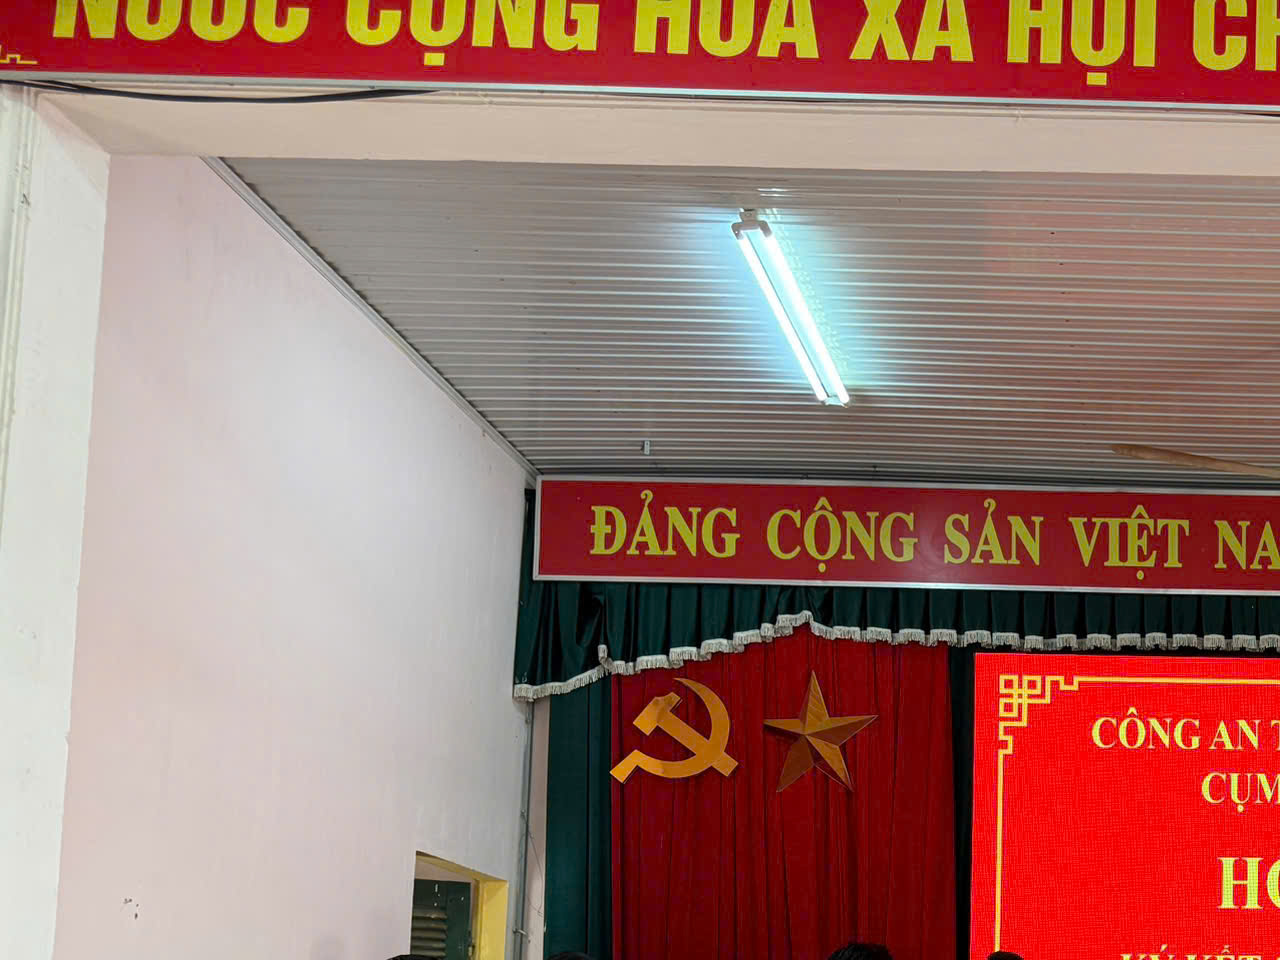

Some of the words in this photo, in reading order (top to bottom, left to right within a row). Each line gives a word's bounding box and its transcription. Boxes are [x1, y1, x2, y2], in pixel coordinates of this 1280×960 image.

[589, 490, 738, 559] ĐẢNG
[767, 497, 917, 573] CỘNG
[943, 498, 1043, 566] SẢN
[1069, 505, 1190, 580] VIỆT
[1091, 706, 1201, 750] CÔNG
[1209, 719, 1261, 750] AN
